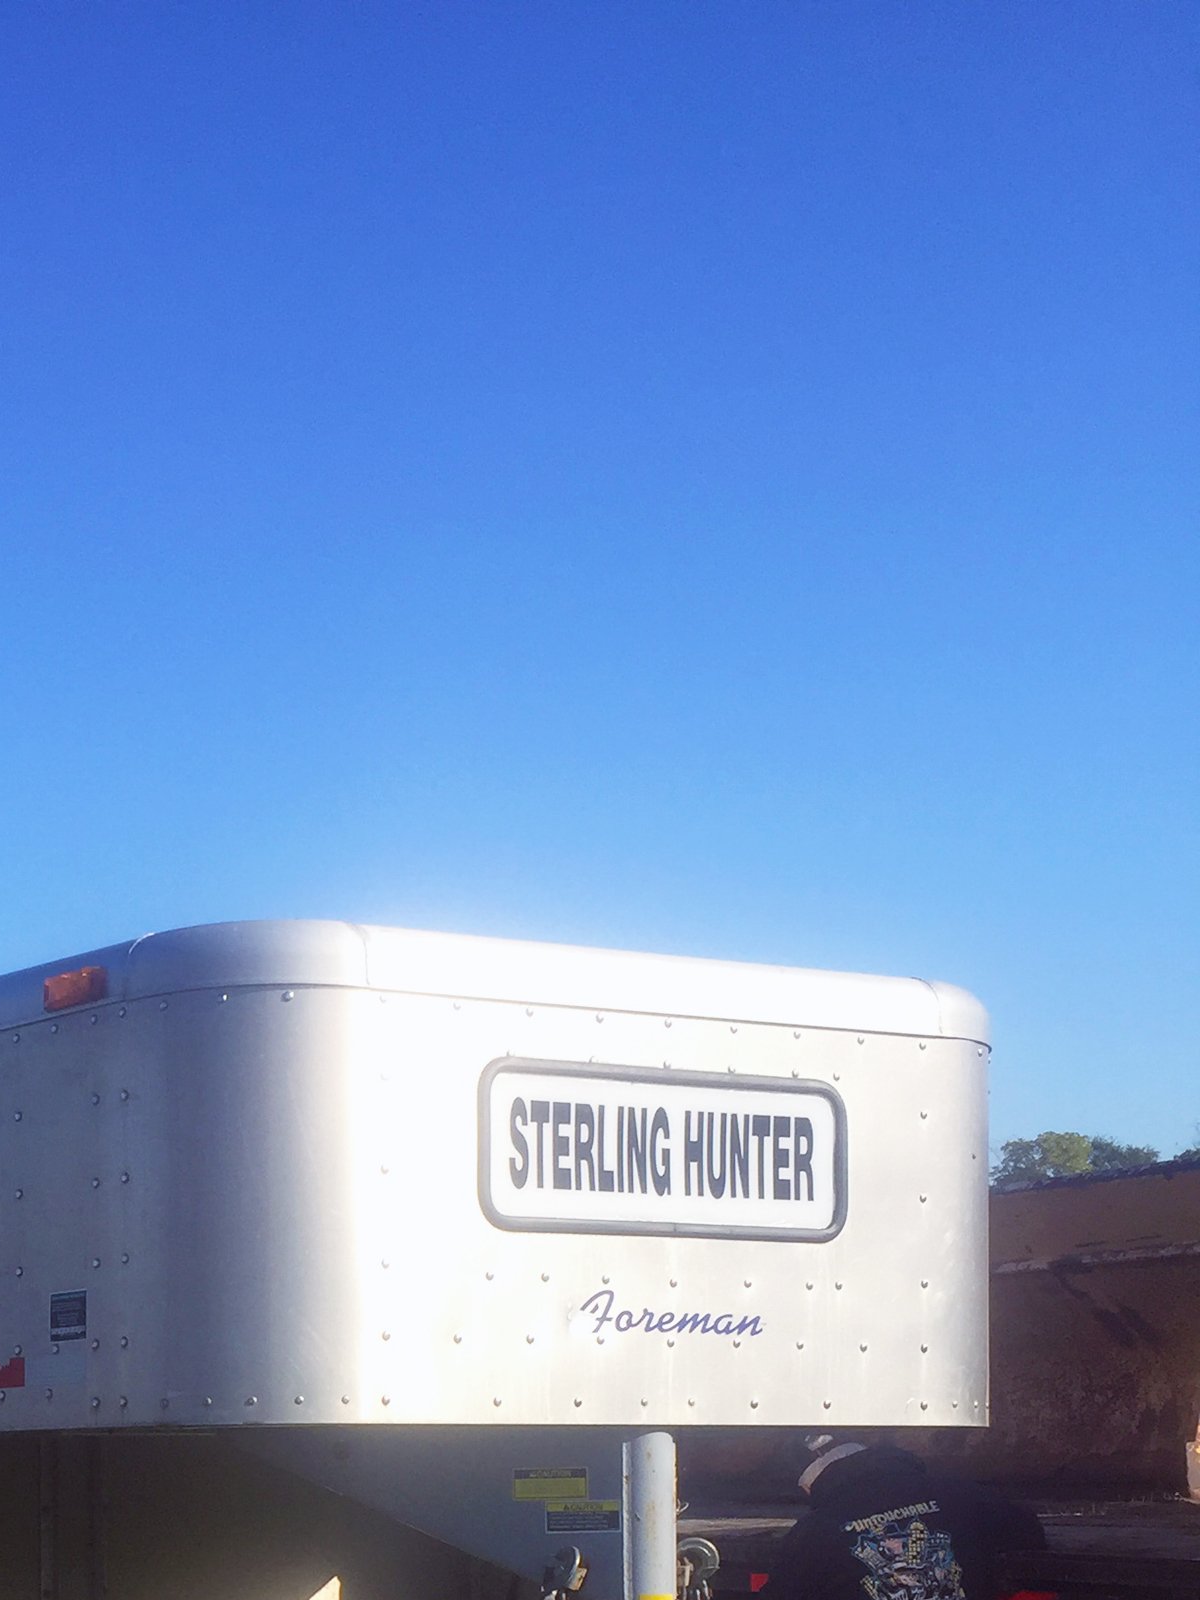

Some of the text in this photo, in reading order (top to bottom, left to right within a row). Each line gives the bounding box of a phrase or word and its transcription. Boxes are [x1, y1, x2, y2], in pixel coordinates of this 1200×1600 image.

[509, 1096, 814, 1201] STERLING HUNTER
[579, 1289, 764, 1337] Foreman
